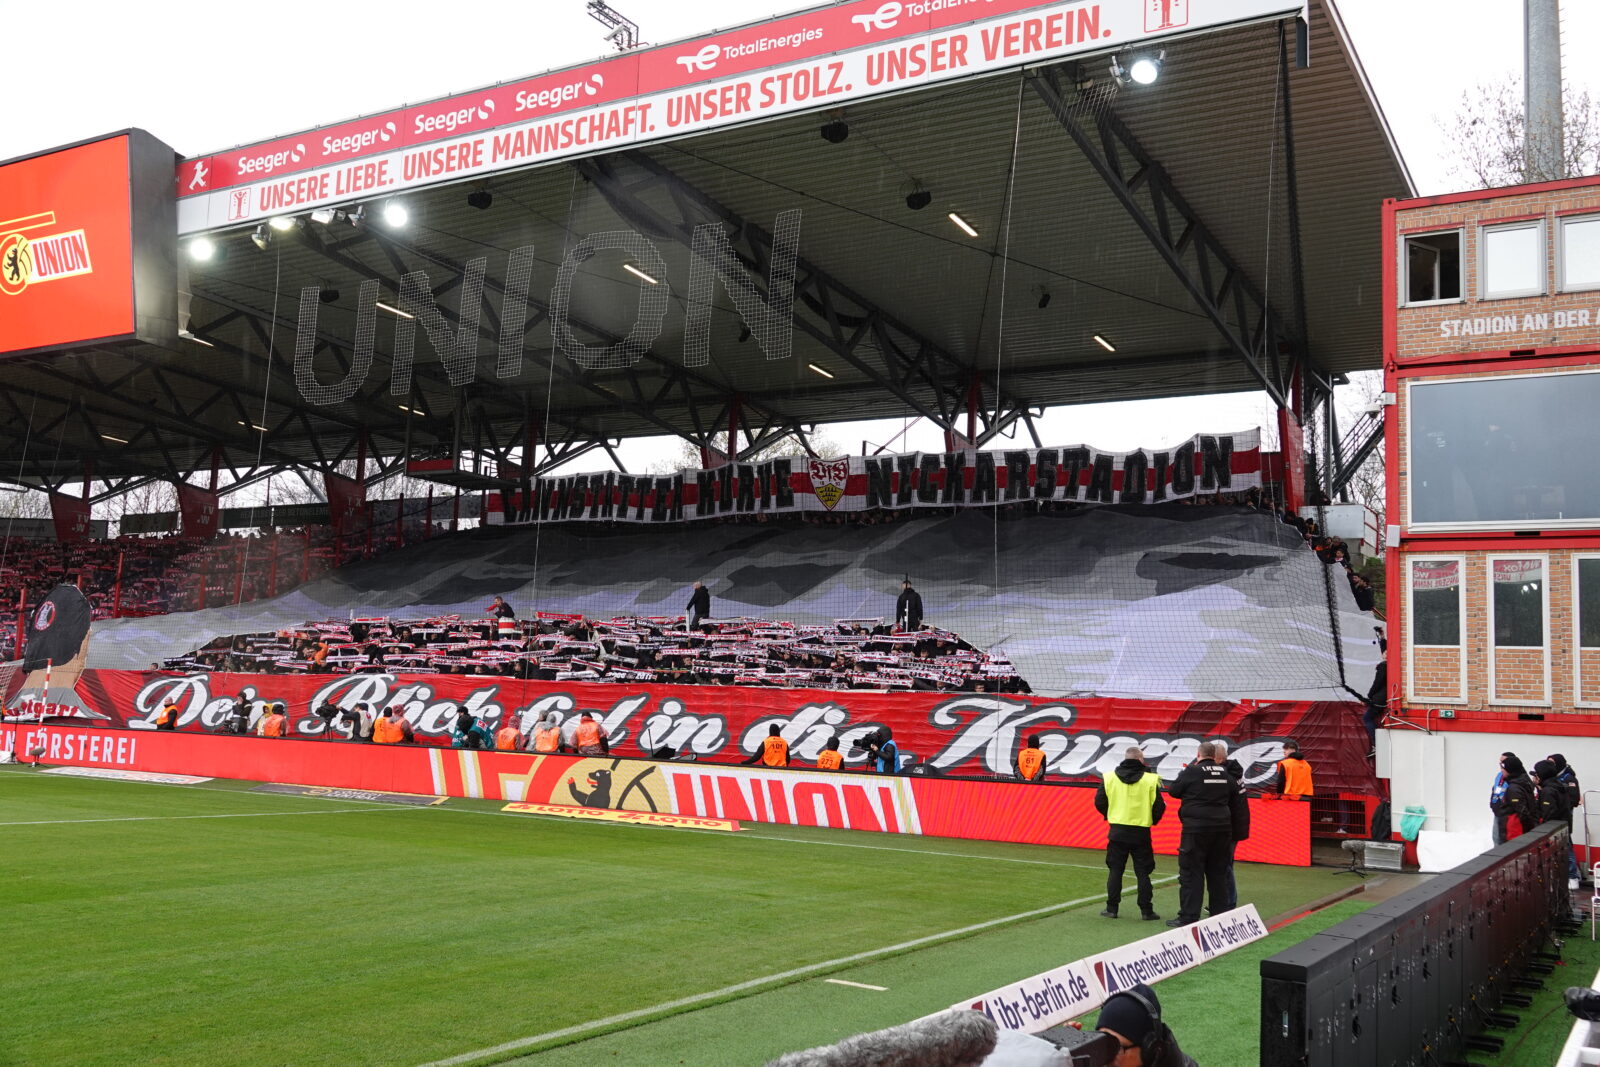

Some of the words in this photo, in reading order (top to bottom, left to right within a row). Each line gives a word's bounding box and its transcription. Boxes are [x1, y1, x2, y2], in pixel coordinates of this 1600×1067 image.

[723, 28, 823, 59] TotalEnergies
[258, 177, 329, 211] UNSERE
[335, 160, 394, 194] LIEBE.
[403, 138, 485, 181] UNSERE
[492, 103, 656, 161] MANNSCHAFT.
[666, 82, 752, 128] UNSER
[760, 62, 853, 109] STOLZ.
[866, 34, 968, 86] UNSER
[980, 5, 1112, 61] VEREIN.
[515, 85, 584, 112] Seeger
[414, 108, 476, 134] Seeger
[322, 130, 379, 156] Seeger
[238, 150, 290, 175] Seeger
[33, 234, 88, 277] UNION
[294, 208, 802, 405] UNION
[1440, 315, 1518, 337] STADION
[1523, 313, 1548, 331] AN
[1553, 309, 1590, 328] DER
[866, 436, 1234, 504] NECKARSTADION
[640, 700, 726, 754] in
[25, 727, 136, 765] FÖRSTEREI
[537, 805, 604, 816] LOTTO
[672, 772, 900, 834] UNION
[649, 815, 722, 827] LOTTO
[1204, 917, 1263, 950] ibr-berlin.de
[1111, 941, 1194, 989] Ingenieurbüro
[997, 968, 1090, 1031] ibr-berlin.de
